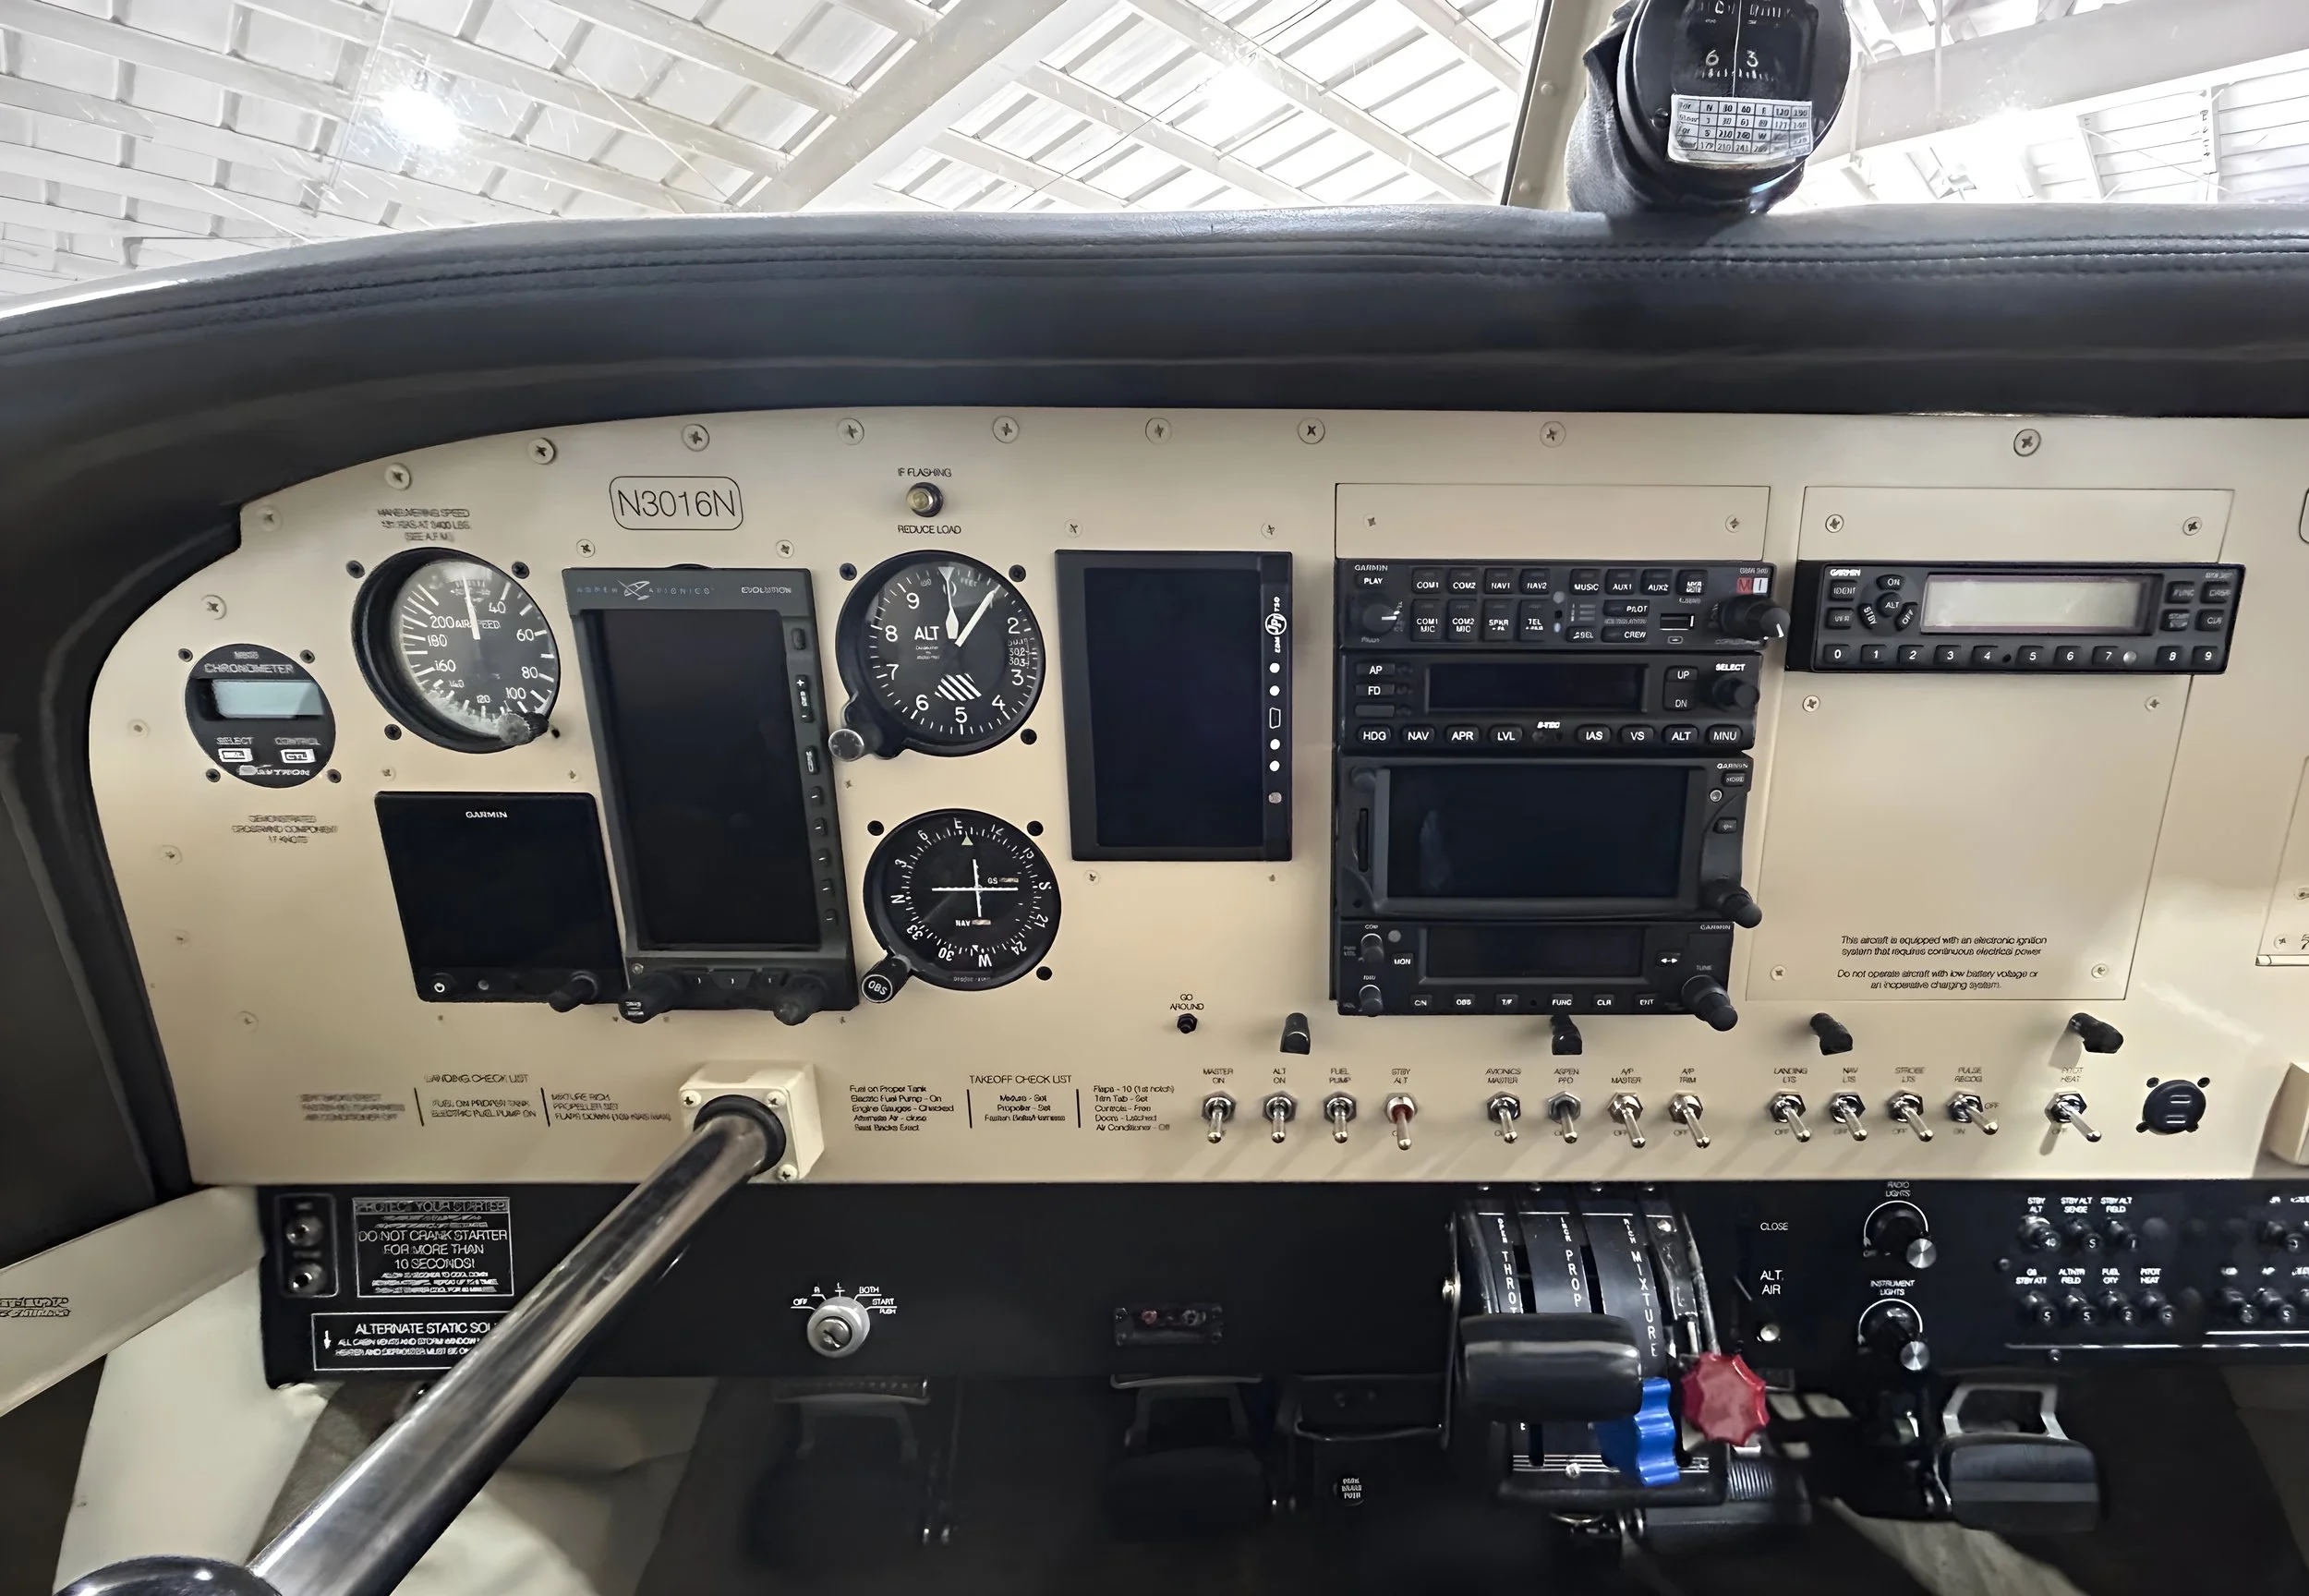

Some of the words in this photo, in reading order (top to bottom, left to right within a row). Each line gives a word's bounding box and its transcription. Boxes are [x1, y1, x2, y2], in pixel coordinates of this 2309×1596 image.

[1706, 50, 1718, 66] 6
[1747, 50, 1759, 66] 3
[907, 468, 951, 477] FLASHING
[618, 490, 735, 517] N3016N
[898, 525, 935, 534] REDUCE
[937, 525, 961, 534] LOAD
[1574, 583, 1599, 591] MUSIC
[906, 592, 920, 610] 9
[489, 601, 506, 615] 40
[429, 615, 454, 630] 200
[1008, 617, 1021, 635] 2
[516, 629, 534, 643] 60
[885, 624, 899, 642] 8
[914, 626, 940, 641] ALT
[427, 635, 449, 648] 180
[1833, 648, 1842, 660] 0
[1874, 649, 1880, 660] 1
[1910, 649, 1918, 661] 2
[1946, 649, 1954, 661] 3
[1983, 650, 1991, 661] 4
[2028, 650, 2037, 662] 5
[2066, 650, 2074, 662] 6
[2105, 650, 2113, 662] 7
[2169, 651, 2177, 661] 8
[2205, 651, 2212, 660] 9
[204, 663, 294, 675] CHRONOMETER
[434, 659, 457, 673] 160
[1369, 666, 1383, 675] AP
[1715, 663, 1746, 671] SELECT
[522, 666, 538, 680] 80
[886, 664, 900, 681] 7
[1011, 669, 1024, 686] 3
[1677, 671, 1689, 679] UP
[506, 686, 526, 700] 100
[1368, 686, 1381, 695] FD
[915, 695, 929, 711] 6
[991, 695, 1006, 710] 4
[1674, 699, 1687, 707] DN
[955, 707, 968, 723] 5
[1362, 731, 1386, 741] HDG
[1408, 732, 1429, 741] NAV
[1451, 732, 1474, 741] APR
[1497, 732, 1516, 741] LVL
[1586, 732, 1603, 741] IAS
[1630, 732, 1645, 741] VS
[1672, 732, 1691, 741] ALT
[1713, 732, 1737, 741] MNU
[465, 810, 507, 818] GARMIN
[954, 817, 963, 828] E
[895, 858, 907, 868] 3
[1039, 881, 1051, 890] S
[890, 894, 905, 904] N
[906, 925, 924, 940] 33
[1842, 936, 1858, 944] This
[1860, 936, 1888, 944] aircraft
[1891, 936, 1898, 944] is
[1900, 936, 1940, 945] equipped
[1974, 936, 2014, 944] electronic
[2016, 936, 2047, 946] ignition
[937, 947, 955, 961] 30
[1842, 948, 1872, 956] system
[1892, 948, 1926, 956] requires
[978, 954, 993, 968] W
[1837, 969, 1850, 977] Do
[1868, 970, 1900, 978] operate
[1966, 970, 1995, 979] battery
[1997, 970, 2027, 979] voltage
[867, 980, 888, 996] OBS
[1930, 980, 1967, 990] charging
[969, 1075, 1012, 1083] TAKEOFF
[1016, 1075, 1050, 1083] CHECK
[1053, 1075, 1072, 1083] LIST
[880, 1085, 905, 1094] Proper
[899, 1094, 922, 1103] Pump
[358, 1230, 377, 1241] DO
[380, 1230, 405, 1241] NOT
[408, 1230, 453, 1240] CRANK
[454, 1229, 507, 1240] STARTER
[383, 1244, 408, 1255] FOR
[412, 1244, 448, 1255] MORE
[451, 1244, 484, 1254] THAN
[394, 1259, 408, 1269] 10
[1566, 1249, 1582, 1308] PROP
[1760, 1270, 1783, 1281] ALT.
[1761, 1285, 1781, 1295] AIR
[1631, 1251, 1658, 1357] MIXTURE
[355, 1323, 423, 1335] ALTERNATE
[427, 1323, 467, 1334] STATIC
